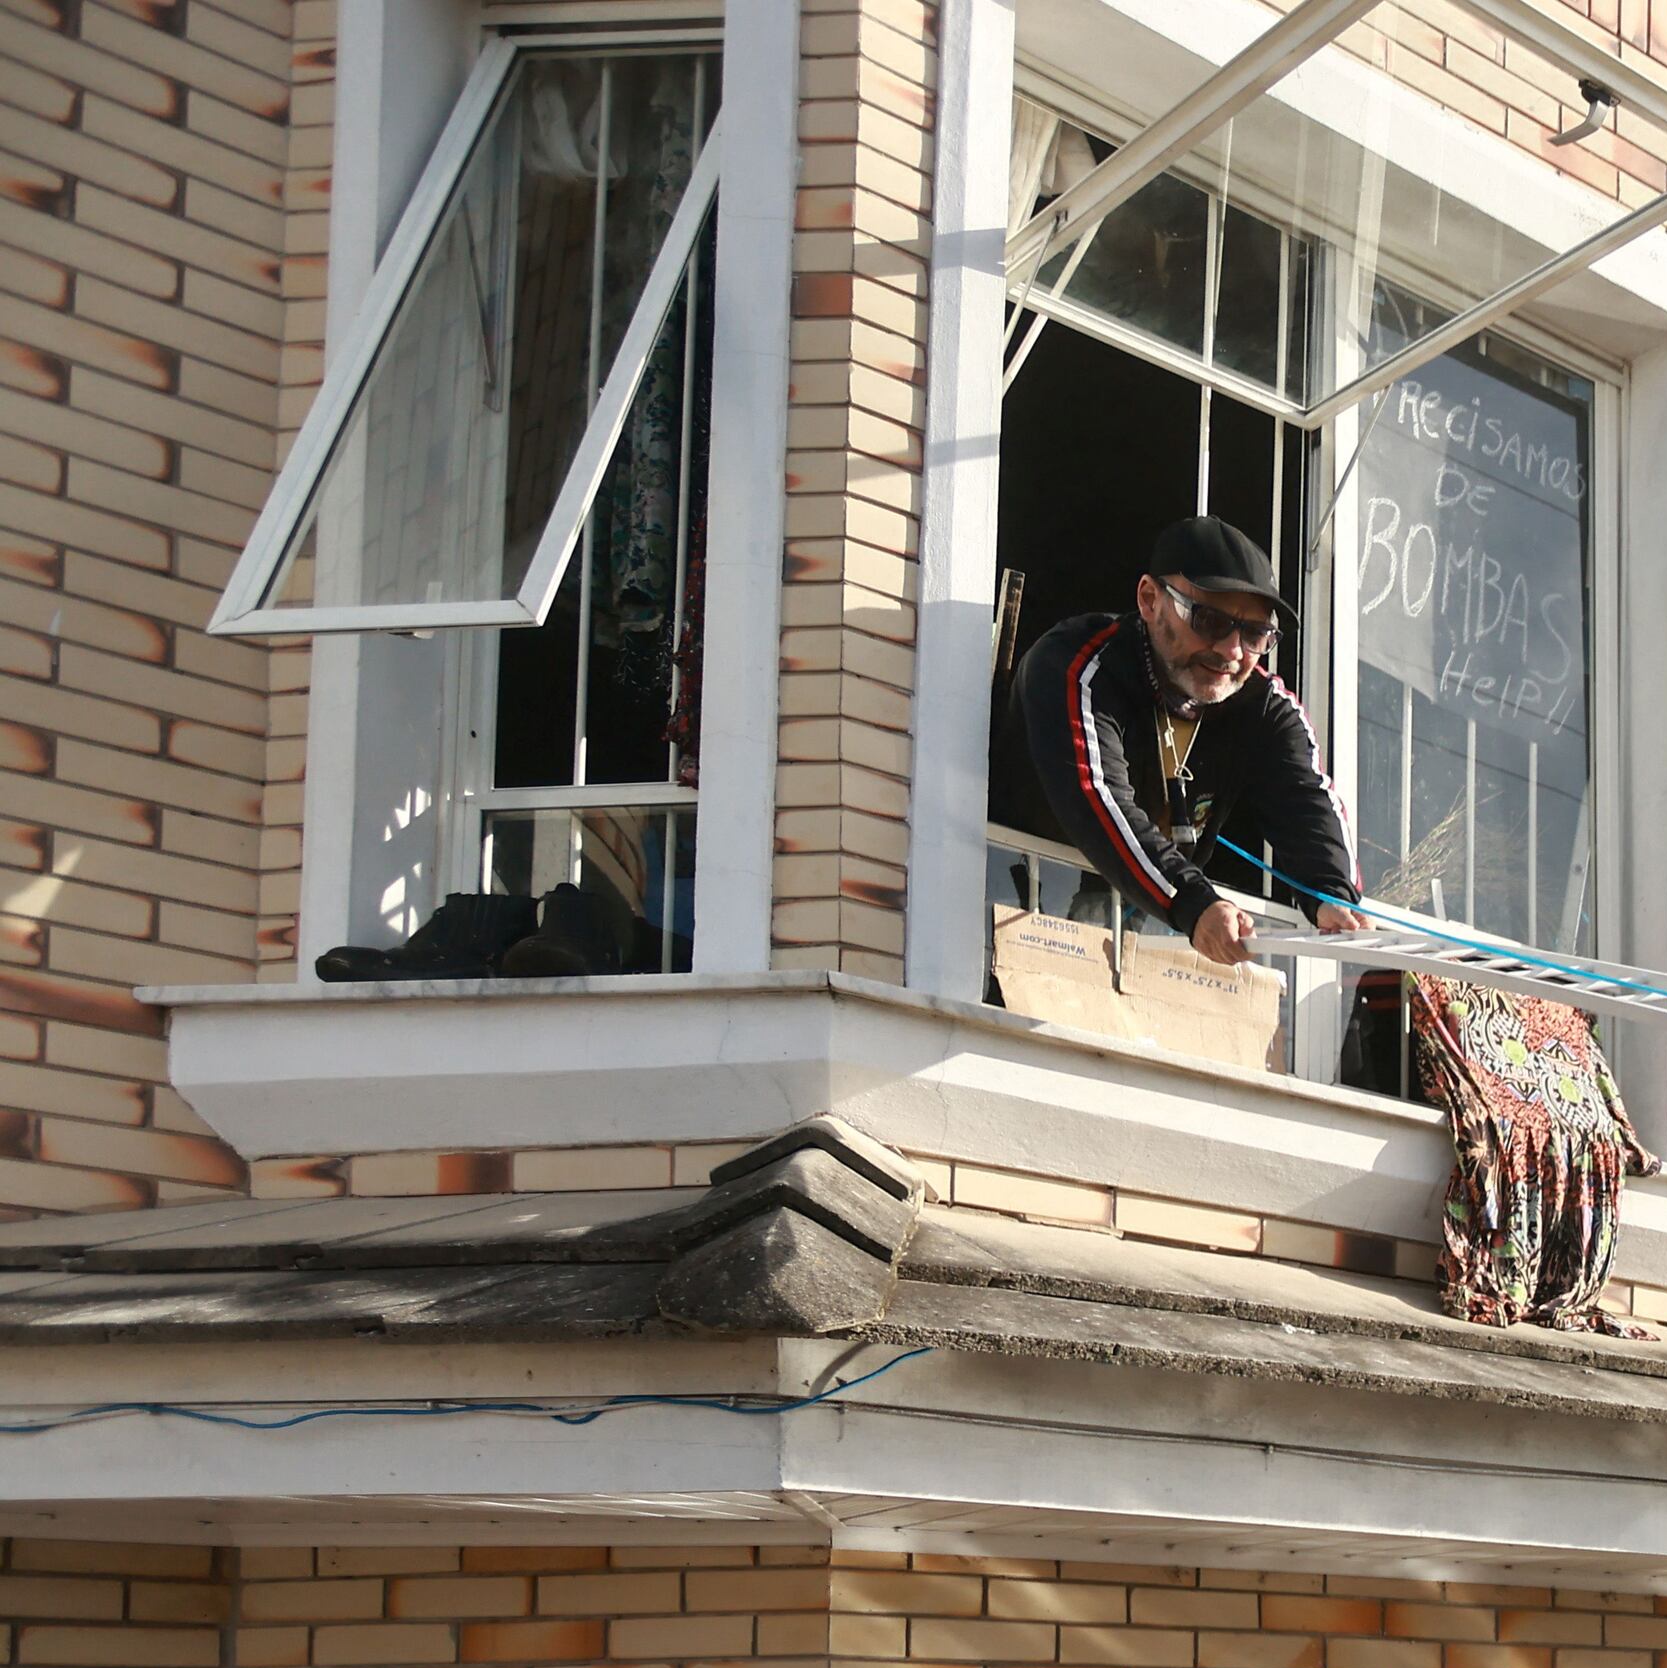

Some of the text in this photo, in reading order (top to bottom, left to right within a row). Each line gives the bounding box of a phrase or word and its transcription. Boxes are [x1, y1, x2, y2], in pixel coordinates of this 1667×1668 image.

[1435, 461, 1496, 517] DE
[1358, 496, 1572, 684] BOMBAS
[1020, 932, 1086, 957] Walmart.com
